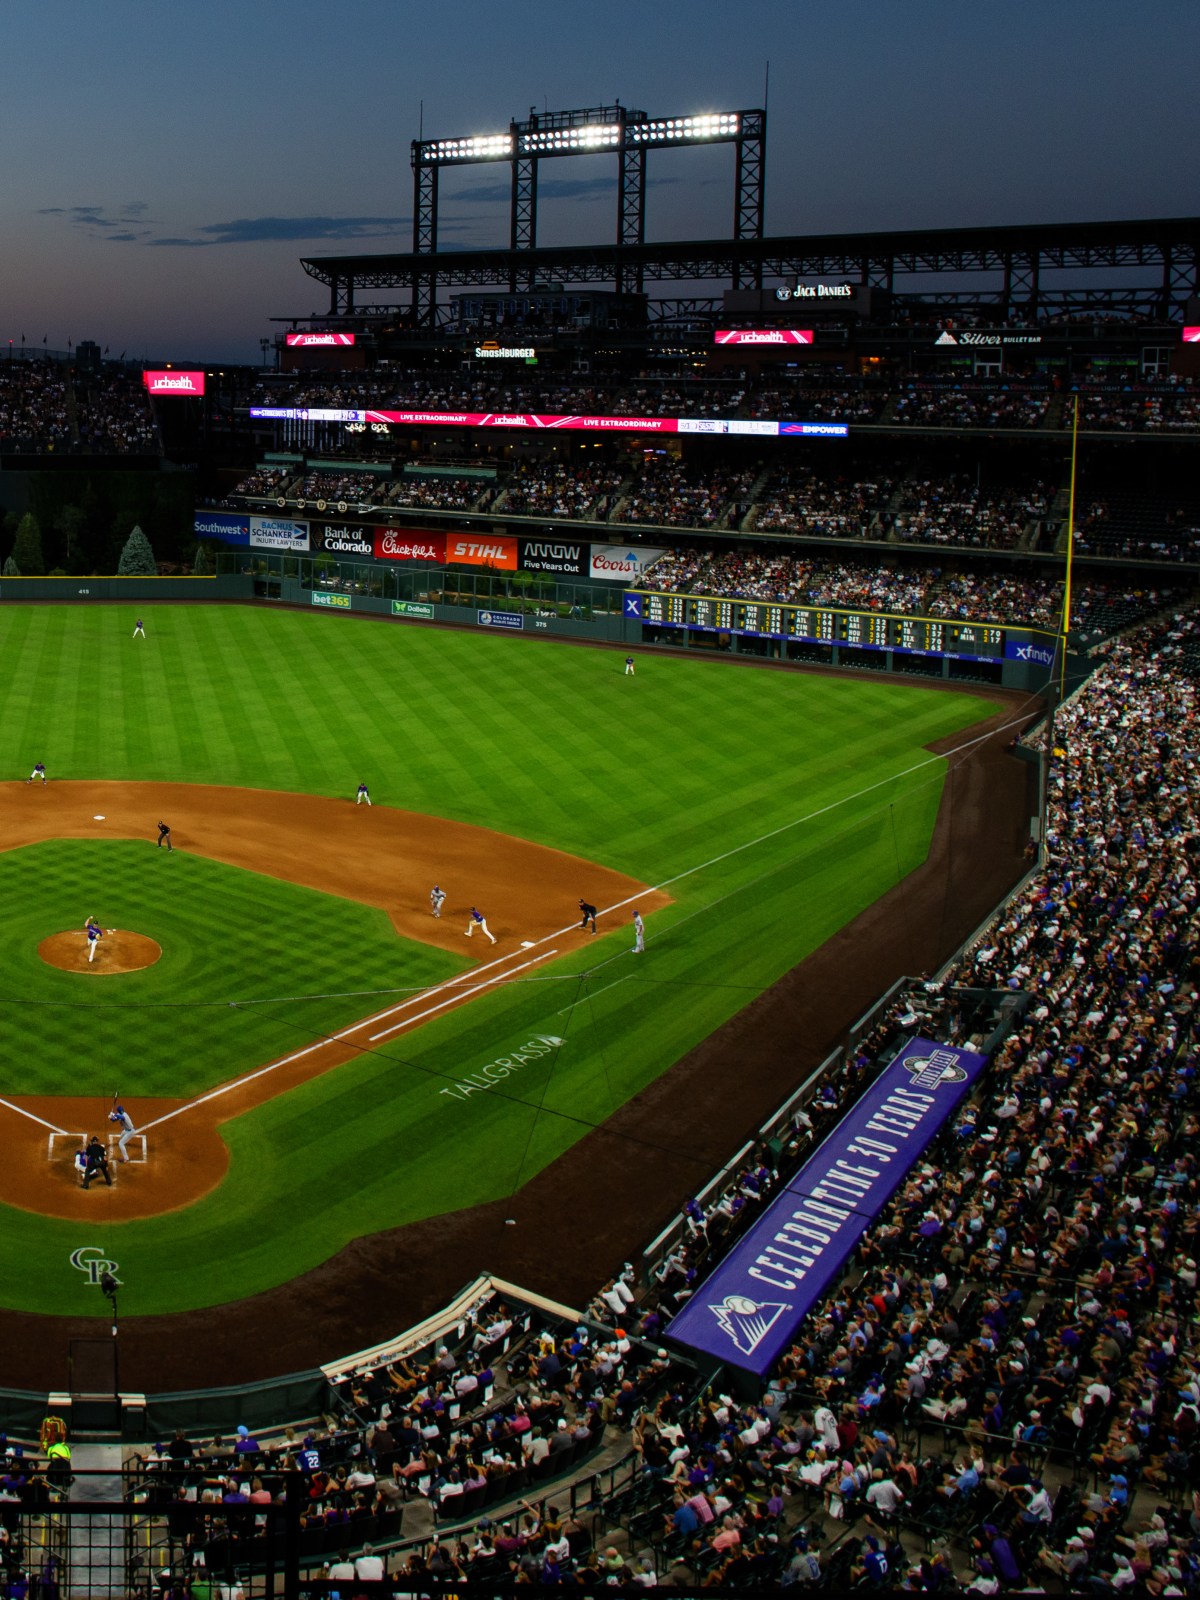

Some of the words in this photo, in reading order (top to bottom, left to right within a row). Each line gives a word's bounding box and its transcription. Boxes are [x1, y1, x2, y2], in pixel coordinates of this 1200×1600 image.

[793, 285, 816, 297] JACK
[817, 284, 851, 296] DANIEL'S
[304, 334, 335, 344] uchealth
[740, 331, 784, 342] uchealth
[958, 332, 1002, 345] Silver
[154, 376, 193, 388] uchealth
[494, 415, 526, 424] uchealth
[597, 420, 661, 428] EXTRAORDINARY
[802, 426, 847, 434] EMPOWER
[194, 522, 241, 535] Southwest
[261, 521, 293, 531] BACHUS
[324, 526, 347, 539] Bank
[348, 528, 363, 539] of
[252, 528, 292, 539] SCHANKER
[256, 537, 276, 545] INJURY
[276, 539, 303, 547] LAWYERS
[324, 538, 372, 553] Colorado
[454, 542, 507, 559] STIHL
[524, 542, 580, 560] ARROW
[524, 560, 540, 569] Five
[541, 561, 561, 571] Years
[563, 563, 580, 573] Out
[591, 554, 631, 572] Coors
[313, 592, 349, 607] bet365
[1016, 645, 1053, 664] xfinity
[440, 1041, 552, 1101] TALLGRASS
[864, 1087, 935, 1138] YEARS
[846, 1135, 898, 1164] 30
[747, 1159, 880, 1291] CELEBRATING
[307, 1456, 319, 1468] 22
